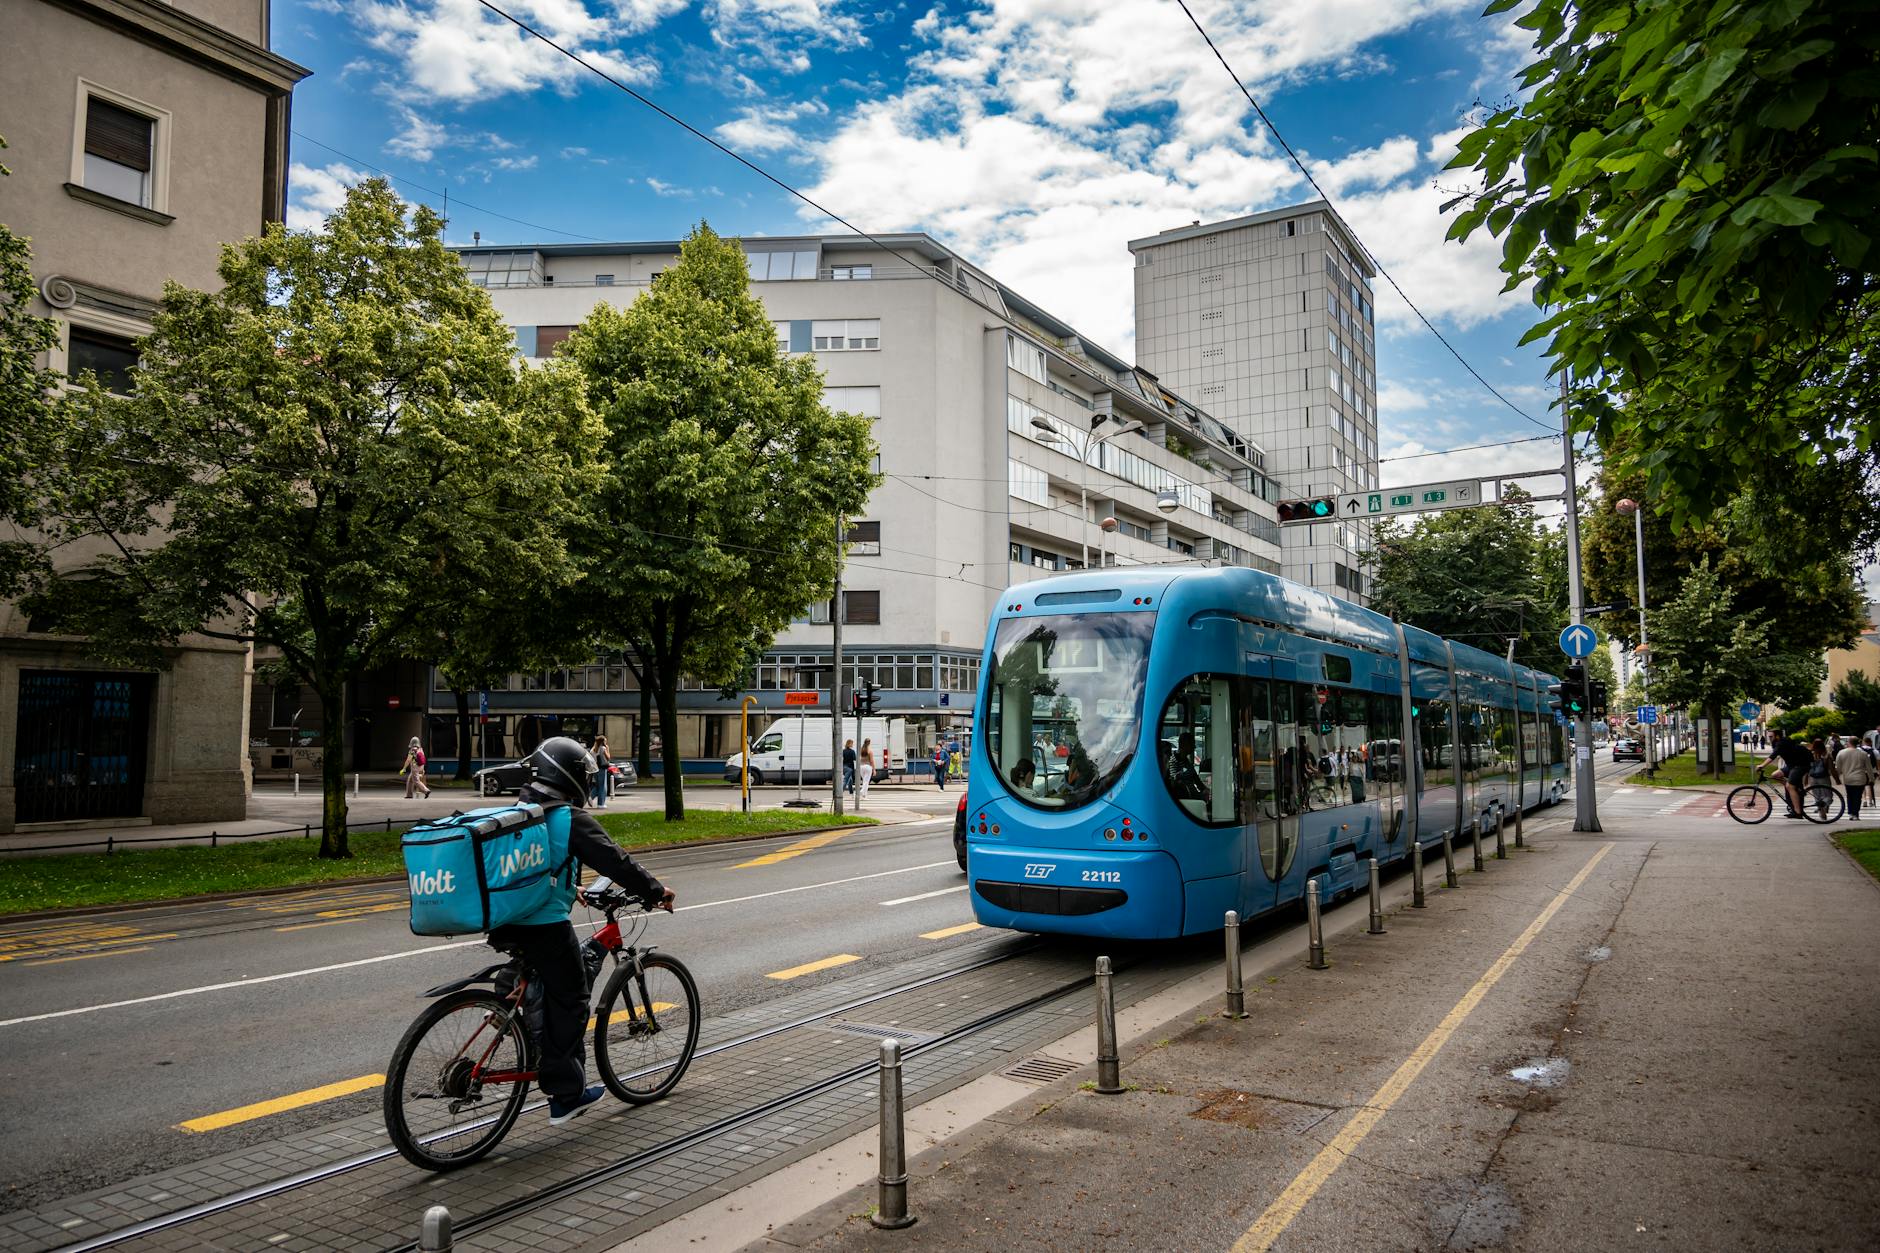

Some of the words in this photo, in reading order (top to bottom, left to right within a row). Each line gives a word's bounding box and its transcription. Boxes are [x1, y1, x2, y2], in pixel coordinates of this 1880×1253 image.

[500, 843, 544, 877] Wolt
[1025, 864, 1056, 878] ZET
[1082, 871, 1120, 882] 22112
[409, 869, 455, 895] Wolt
